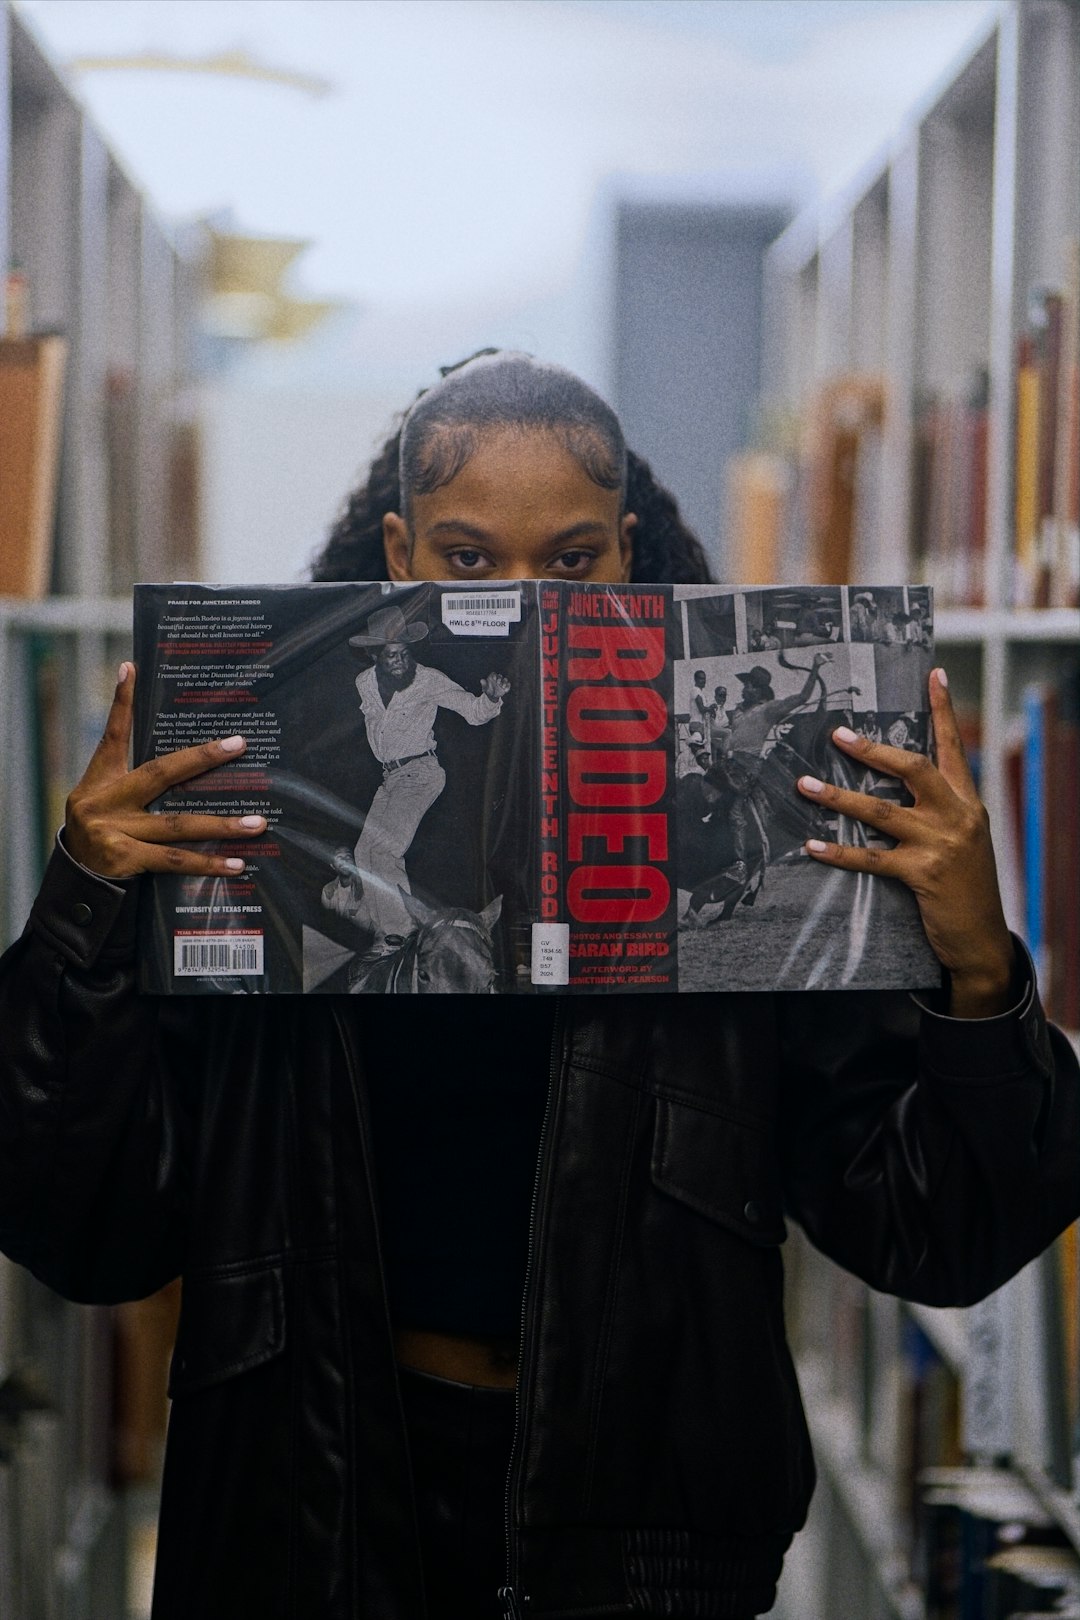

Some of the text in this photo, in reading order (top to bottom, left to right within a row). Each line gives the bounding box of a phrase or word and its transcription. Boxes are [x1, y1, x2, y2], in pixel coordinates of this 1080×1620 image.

[568, 594, 665, 619] JUNETEENTH
[541, 613, 558, 923] JUNETEENTH ROD
[566, 624, 670, 923] RODEO
[569, 942, 670, 957] SARAH BIRD
